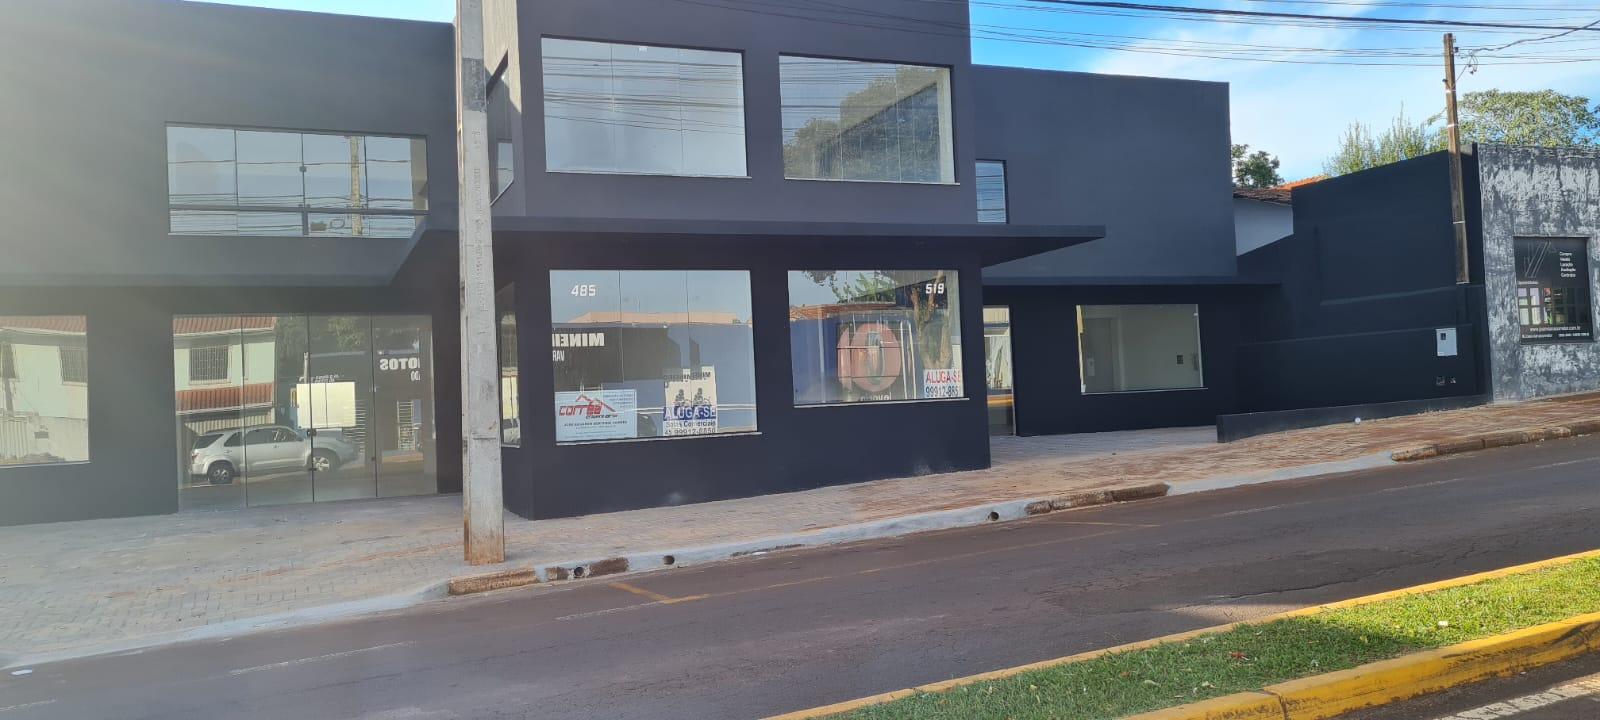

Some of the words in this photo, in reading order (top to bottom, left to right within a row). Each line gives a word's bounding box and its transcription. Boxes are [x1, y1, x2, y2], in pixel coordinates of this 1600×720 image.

[571, 285, 596, 297] 485
[926, 283, 945, 294] 519
[664, 406, 716, 420] ALUGA-SE
